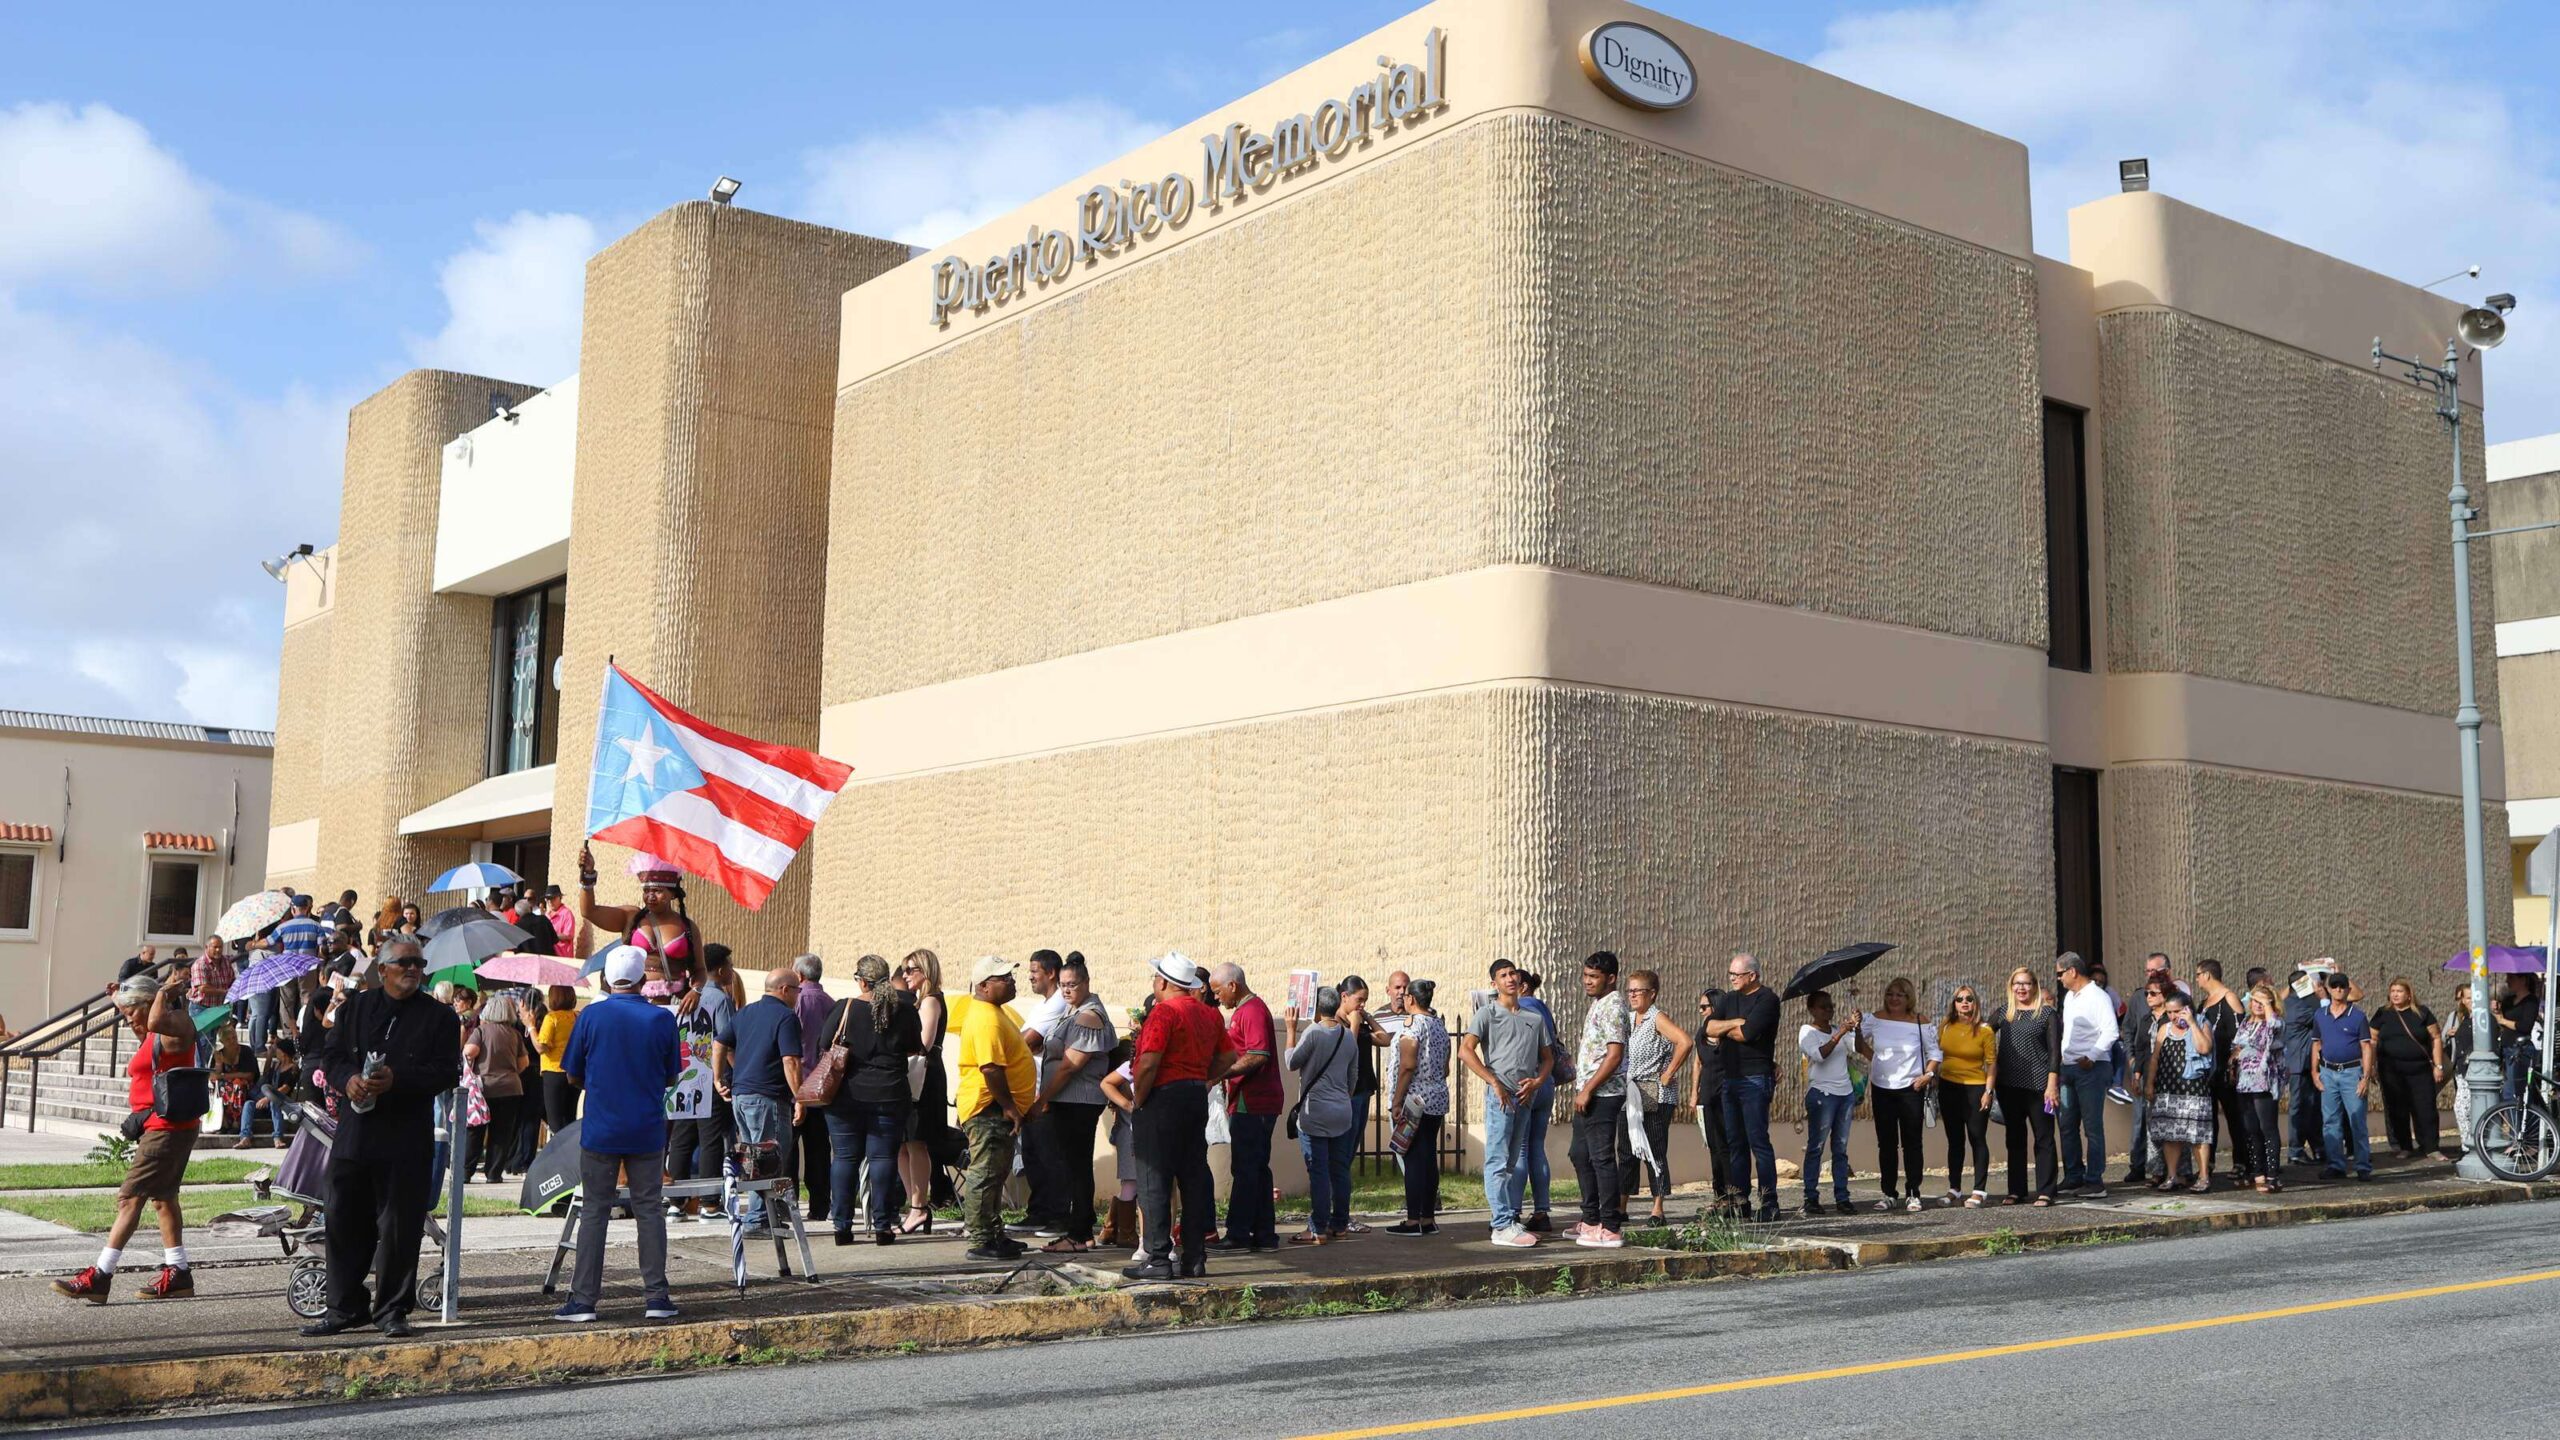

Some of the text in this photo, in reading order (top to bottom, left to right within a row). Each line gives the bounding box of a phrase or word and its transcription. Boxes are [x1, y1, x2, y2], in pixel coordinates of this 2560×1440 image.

[1602, 36, 1685, 96] Dignity
[930, 26, 1447, 325] Puerto Rico Memorial
[540, 1176, 562, 1195] MCS
